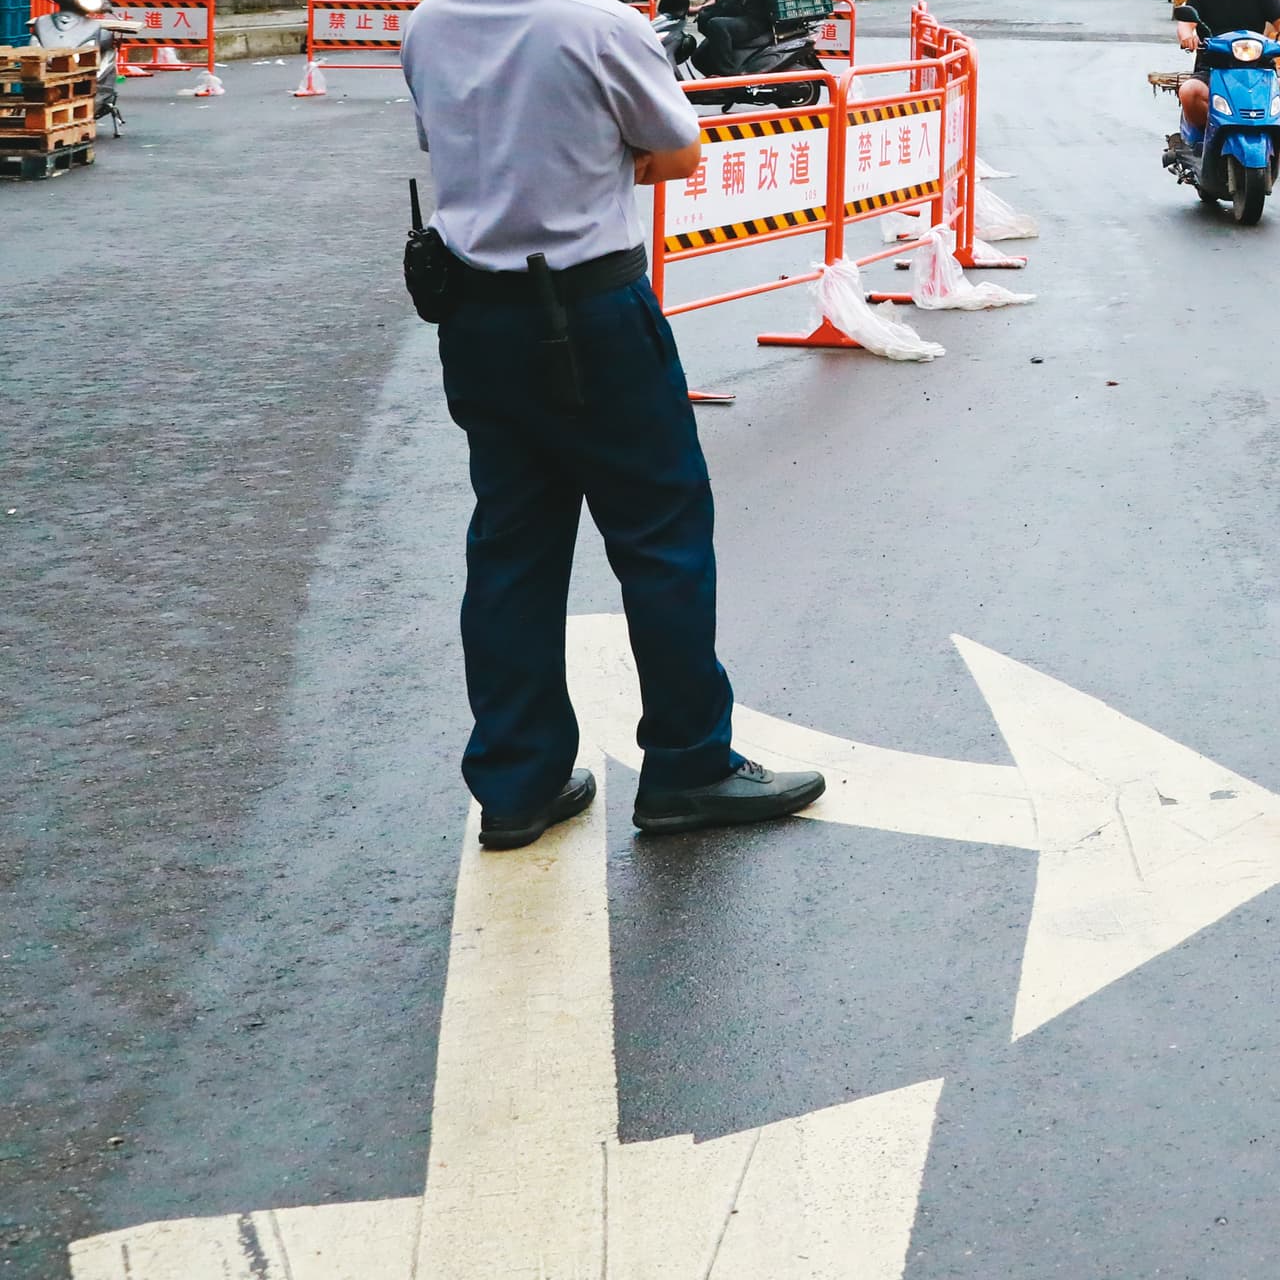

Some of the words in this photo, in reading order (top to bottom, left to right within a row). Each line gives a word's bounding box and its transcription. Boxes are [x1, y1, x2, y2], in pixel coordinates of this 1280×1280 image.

[329, 12, 400, 31] 禁止進
[684, 140, 811, 201] 車輛改道
[858, 122, 931, 172] 禁止進入
